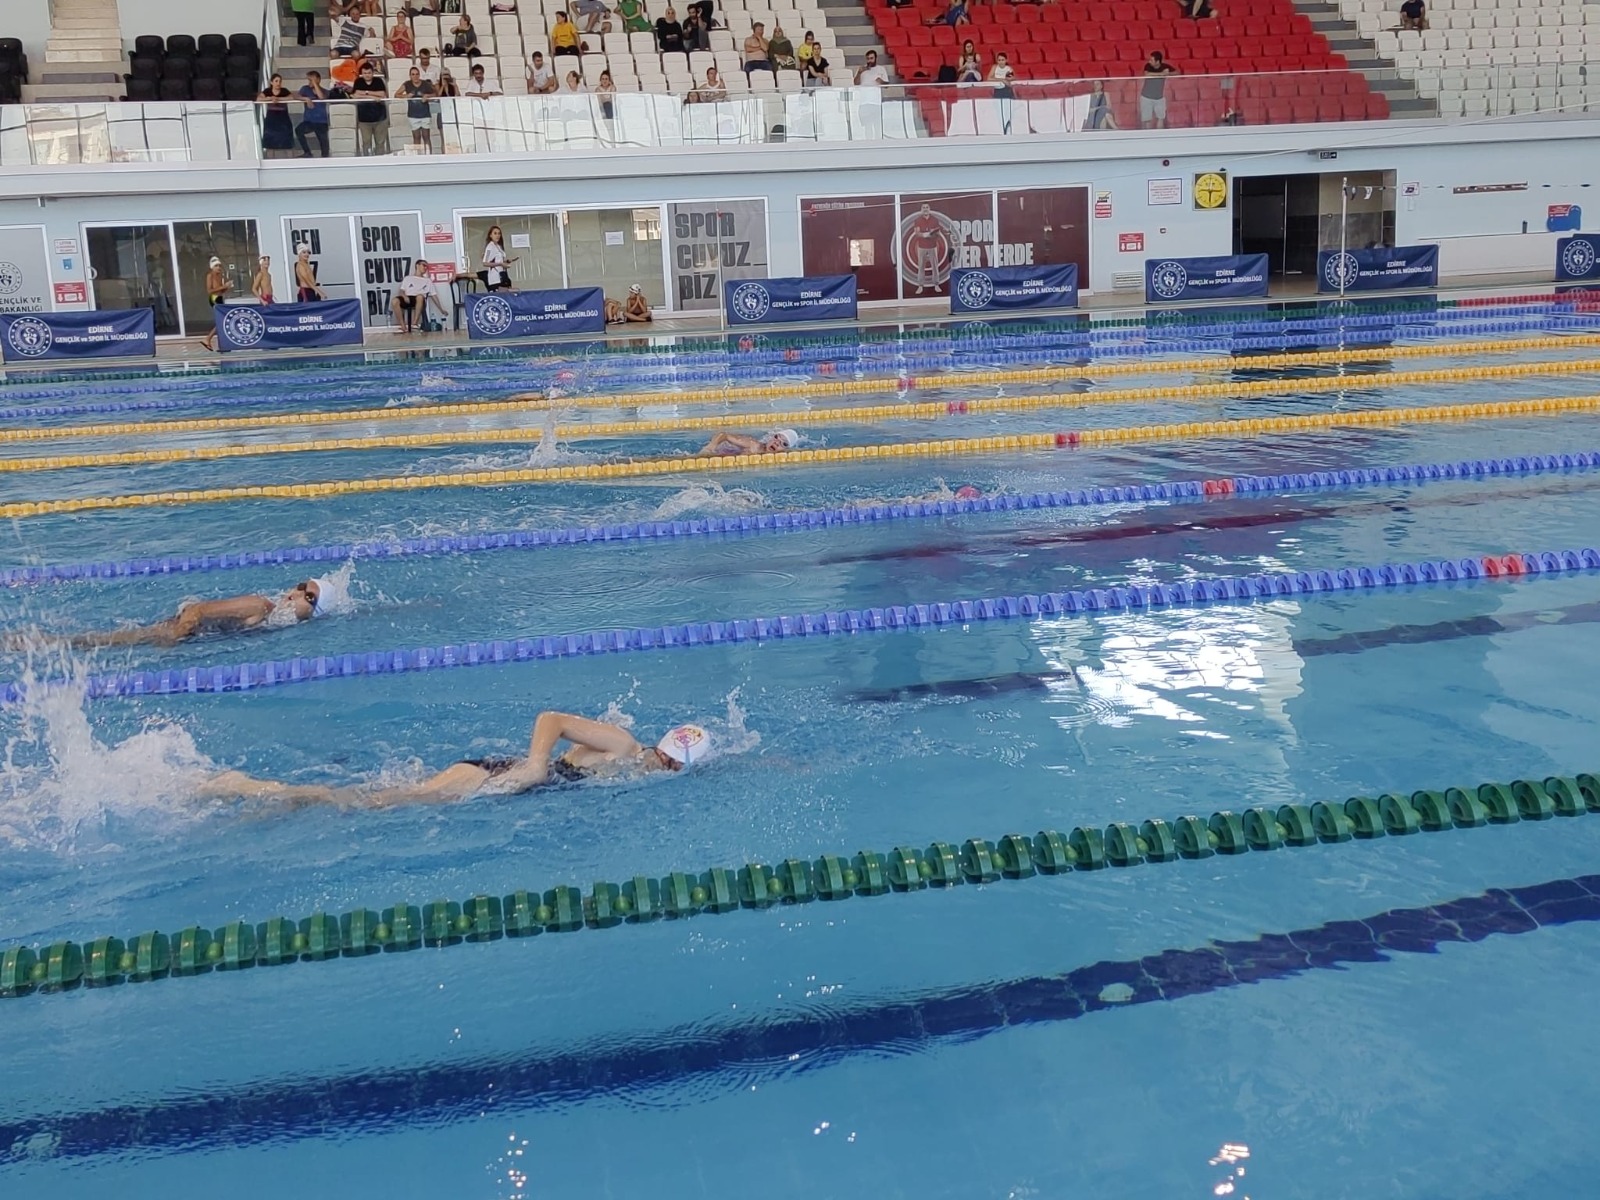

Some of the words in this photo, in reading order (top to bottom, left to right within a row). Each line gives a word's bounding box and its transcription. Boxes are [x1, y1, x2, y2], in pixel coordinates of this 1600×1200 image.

[675, 212, 735, 238] SPOR
[950, 220, 994, 242] SPOR
[362, 226, 402, 252] SPOR
[677, 242, 751, 269] CUYUZ
[364, 256, 412, 284] CUYUZ
[678, 272, 717, 300] BİZ
[367, 287, 392, 315] BİZ
[268, 326, 291, 334] GENÇLİK
[298, 316, 323, 324] EDİRNE
[514, 314, 537, 322] GENÇLİK
